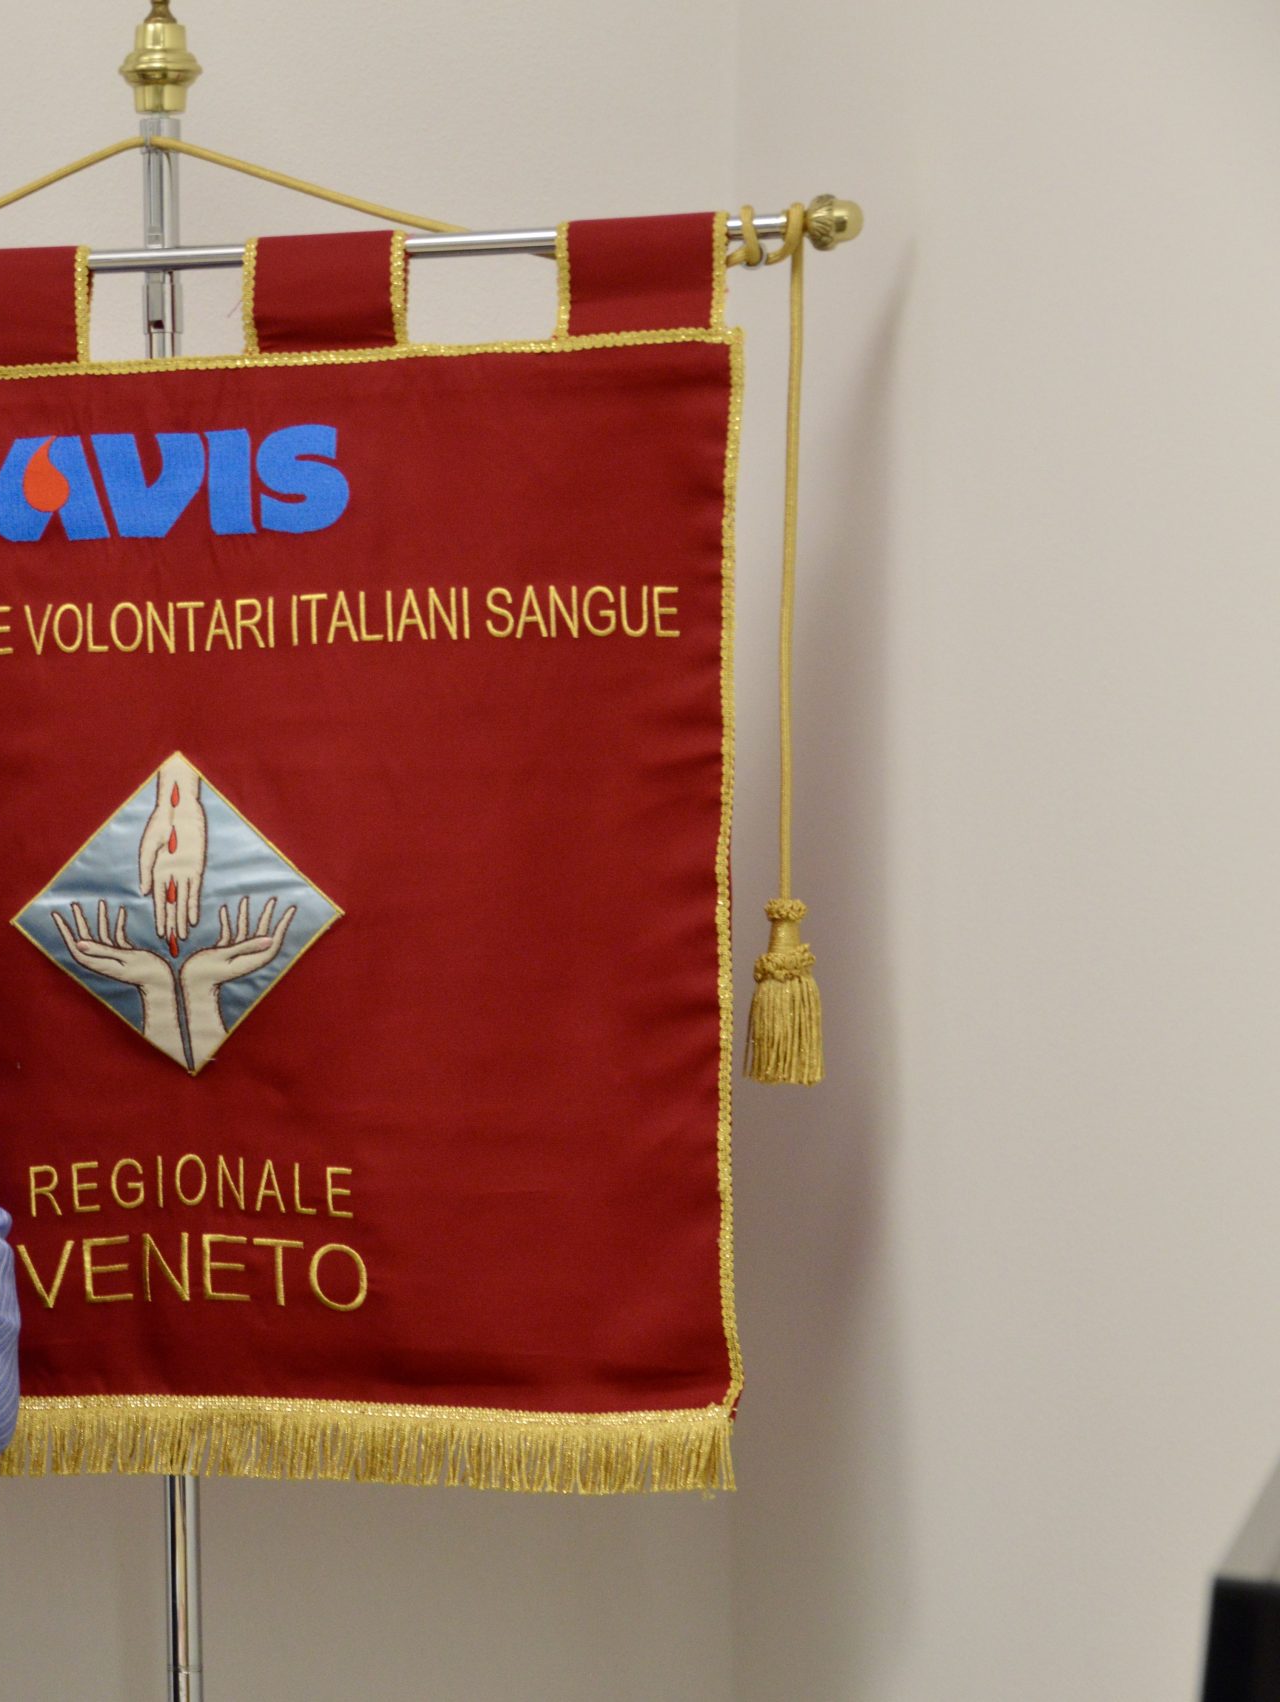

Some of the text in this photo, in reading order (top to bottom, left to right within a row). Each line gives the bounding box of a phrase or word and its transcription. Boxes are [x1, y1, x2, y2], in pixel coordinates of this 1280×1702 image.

[23, 594, 276, 656] VOLONTARI
[290, 586, 471, 647] ITALIANI
[485, 584, 682, 639] SANGUE
[28, 1153, 354, 1219] REGIONALE
[16, 1231, 368, 1312] VENETO
